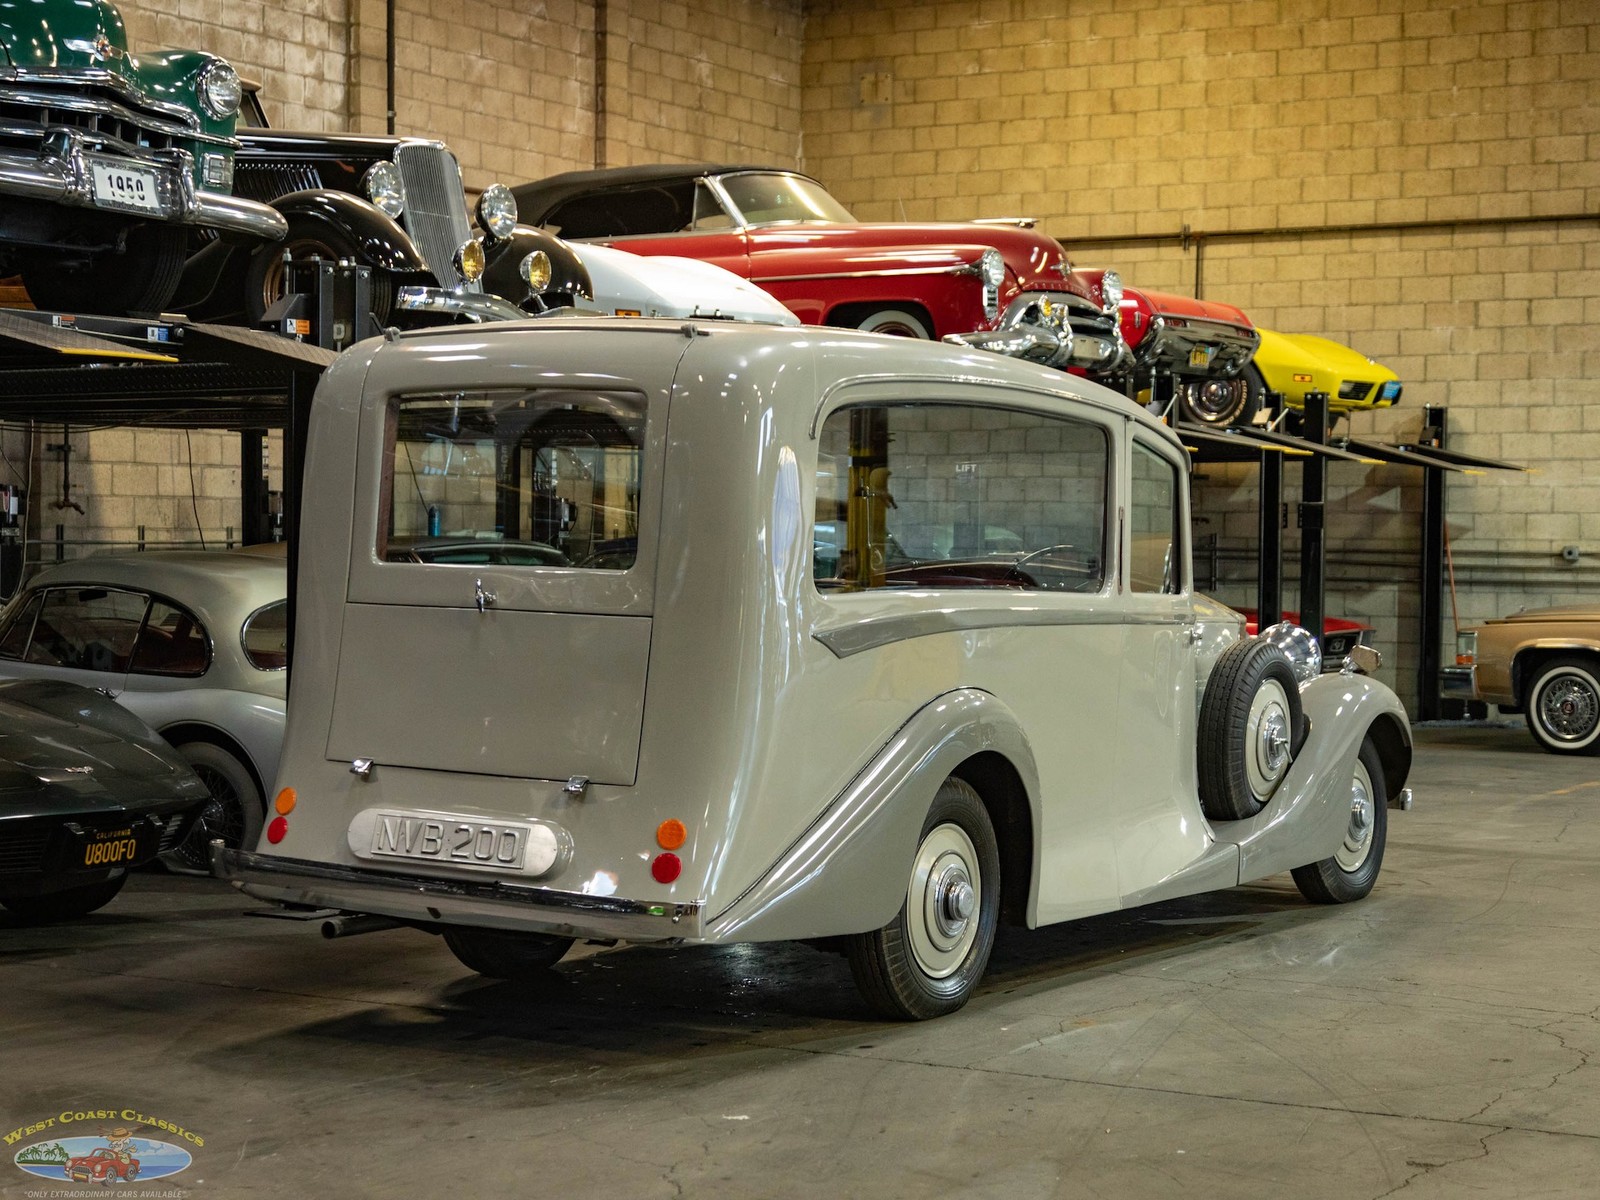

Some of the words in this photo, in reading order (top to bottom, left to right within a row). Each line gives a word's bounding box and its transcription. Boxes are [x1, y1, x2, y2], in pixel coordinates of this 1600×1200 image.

[108, 174, 146, 201] 1950
[955, 464, 977, 472] LIFT
[377, 818, 445, 855] NVB
[450, 824, 520, 864] 200
